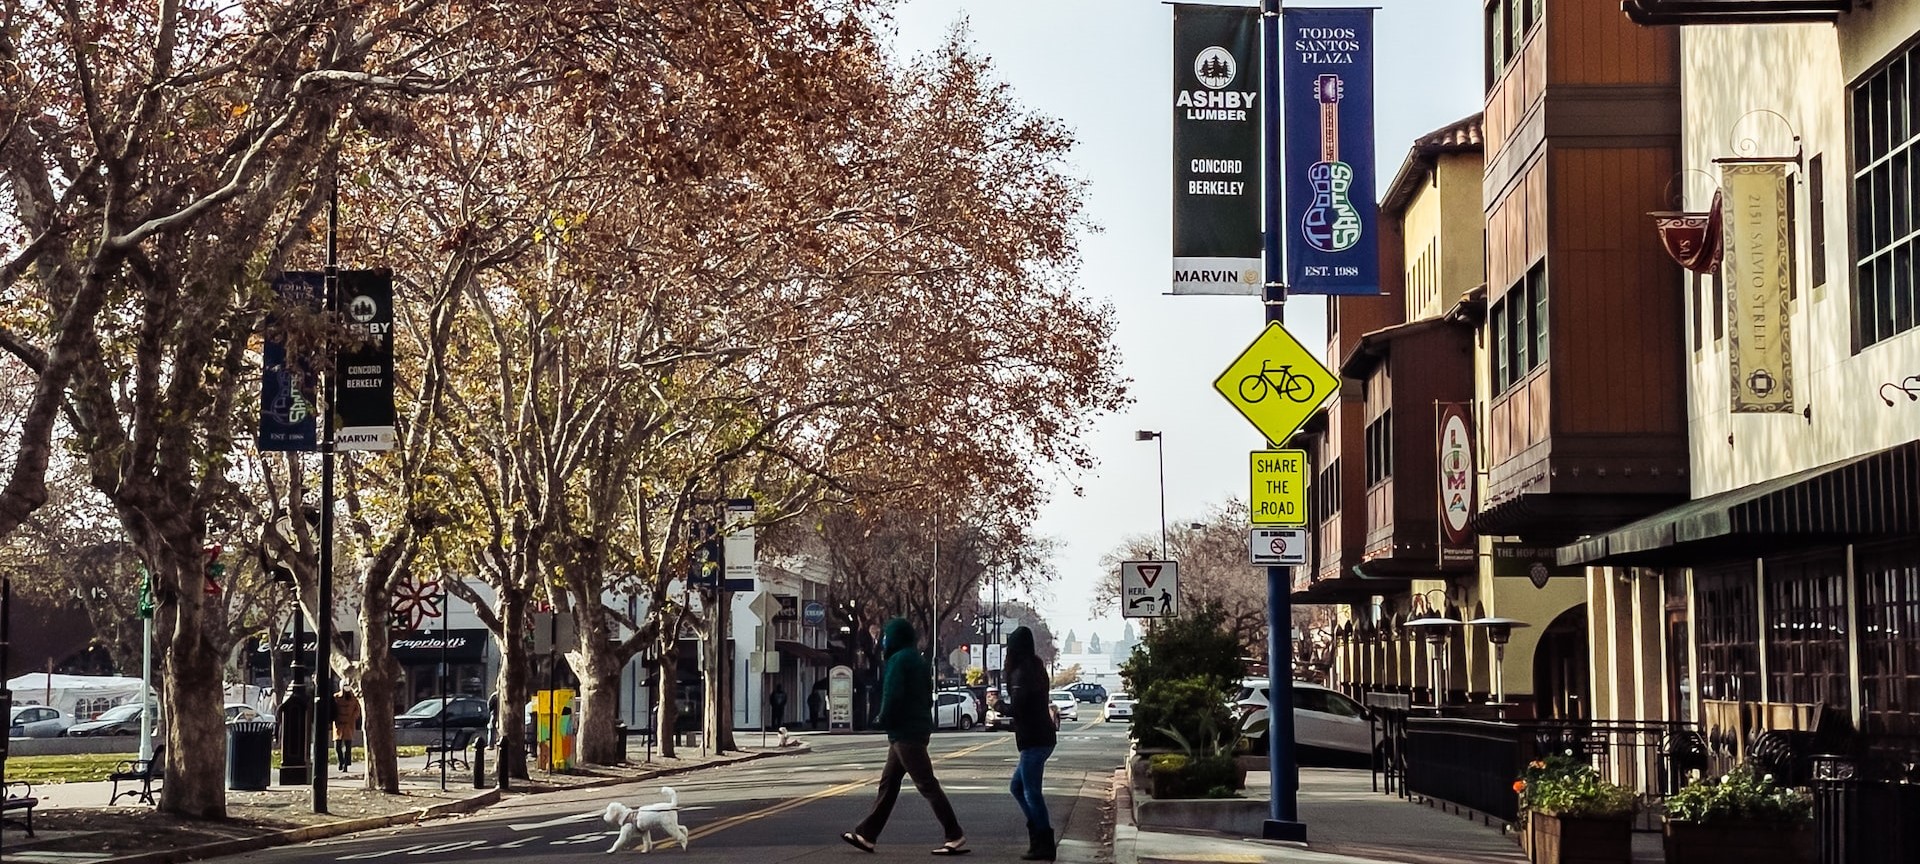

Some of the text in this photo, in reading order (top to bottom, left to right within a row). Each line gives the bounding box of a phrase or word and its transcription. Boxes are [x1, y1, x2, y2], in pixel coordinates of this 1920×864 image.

[1299, 28, 1355, 39] TODOS
[1295, 40, 1360, 52] SANTOS
[1302, 53, 1353, 64] PLAZA
[1176, 90, 1257, 109] ASHBY
[1187, 109, 1247, 122] LUMBER
[1191, 158, 1242, 175] CONCORD
[1188, 180, 1244, 196] BERKELEY
[1306, 164, 1331, 247] TODOS
[1331, 164, 1360, 250] SANTOS
[1175, 269, 1238, 284] MARVIN
[1304, 266, 1359, 277] EST. 1988
[1749, 194, 1767, 351] 2151 SALVIO STREET
[348, 366, 381, 374] CONCORD
[346, 379, 382, 388] BERKELEY
[337, 434, 378, 443] MARVIN
[1257, 459, 1298, 474] SHARE
[1447, 429, 1467, 512] LIMA
[1266, 481, 1289, 494] THE
[1261, 502, 1295, 516] ROAD
[1497, 548, 1514, 558] THE
[1516, 548, 1535, 558] HOP
[1128, 587, 1147, 596] HERE
[1146, 603, 1155, 612] TO
